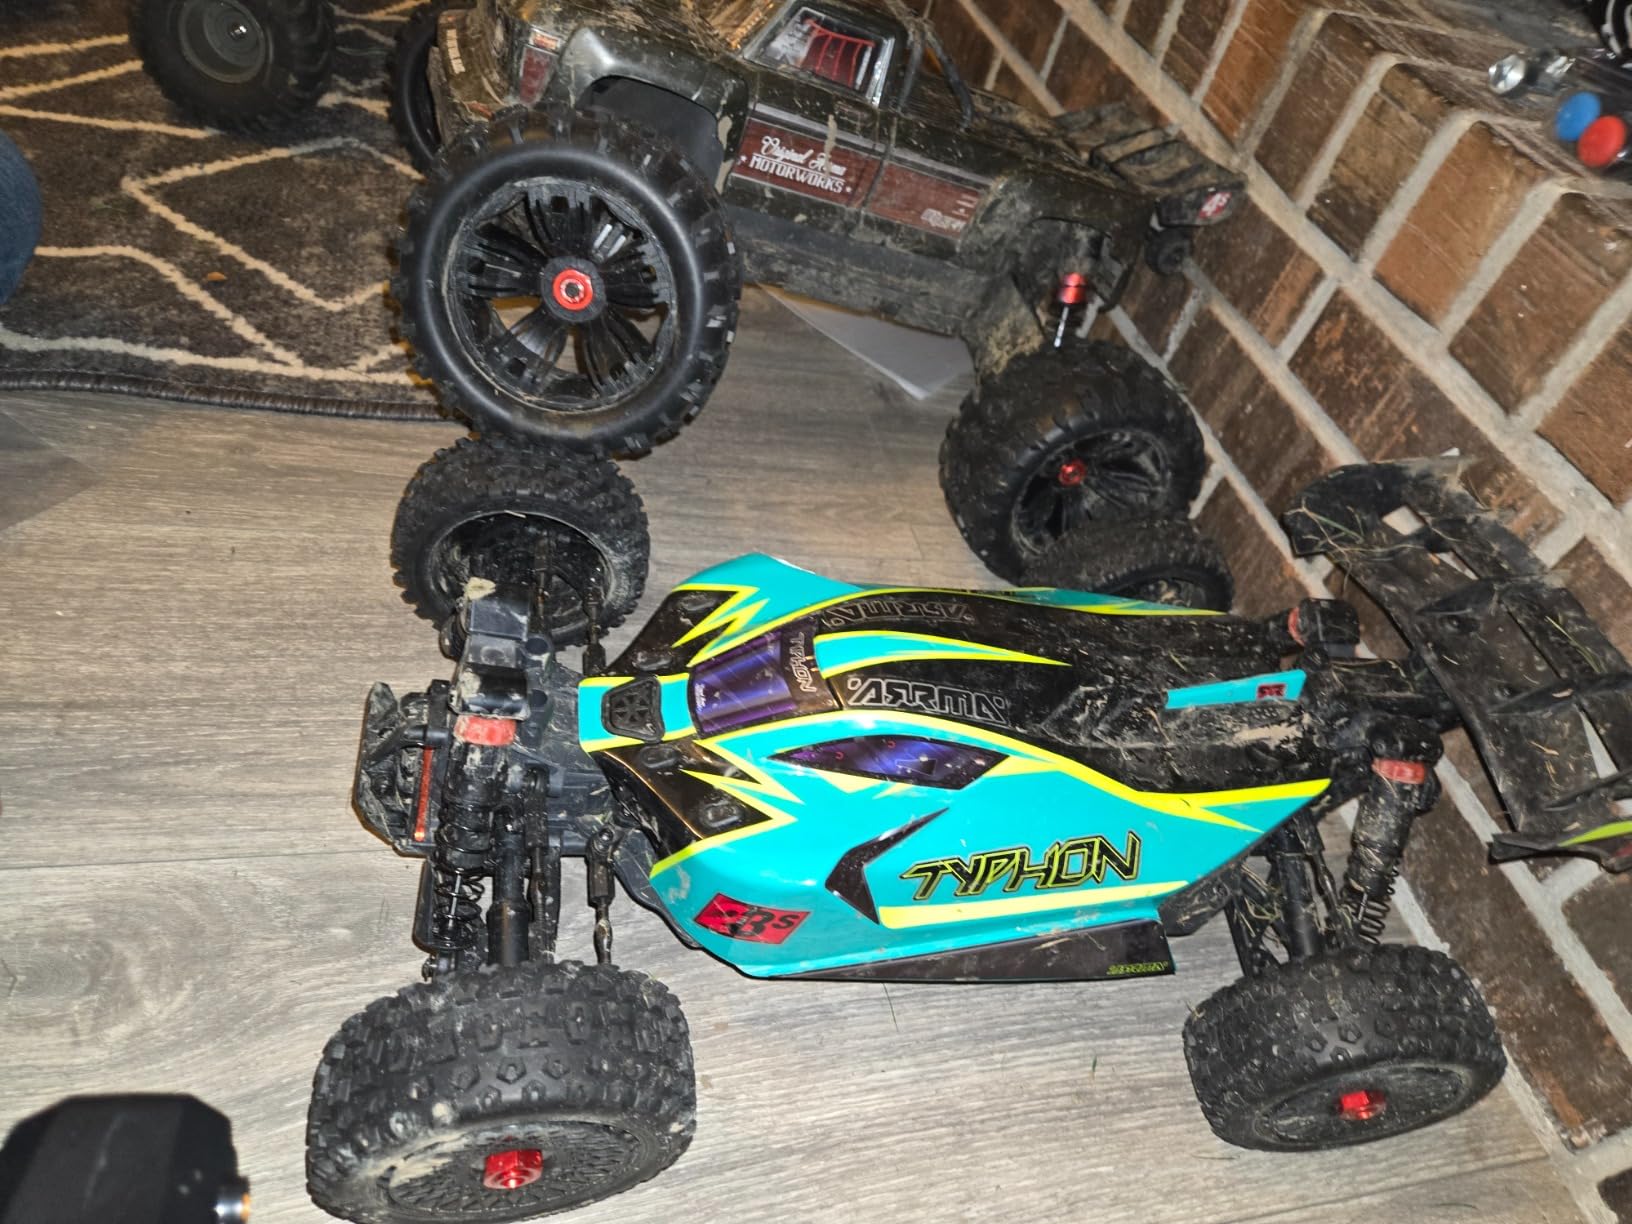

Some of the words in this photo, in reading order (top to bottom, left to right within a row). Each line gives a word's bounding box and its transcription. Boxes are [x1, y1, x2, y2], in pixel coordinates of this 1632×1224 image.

[761, 135, 814, 164] Original
[749, 155, 846, 193] MOTORWORKS
[790, 632, 817, 692] TYPHON
[847, 677, 1012, 724] ARRMA
[900, 830, 1142, 900] TYPHON
